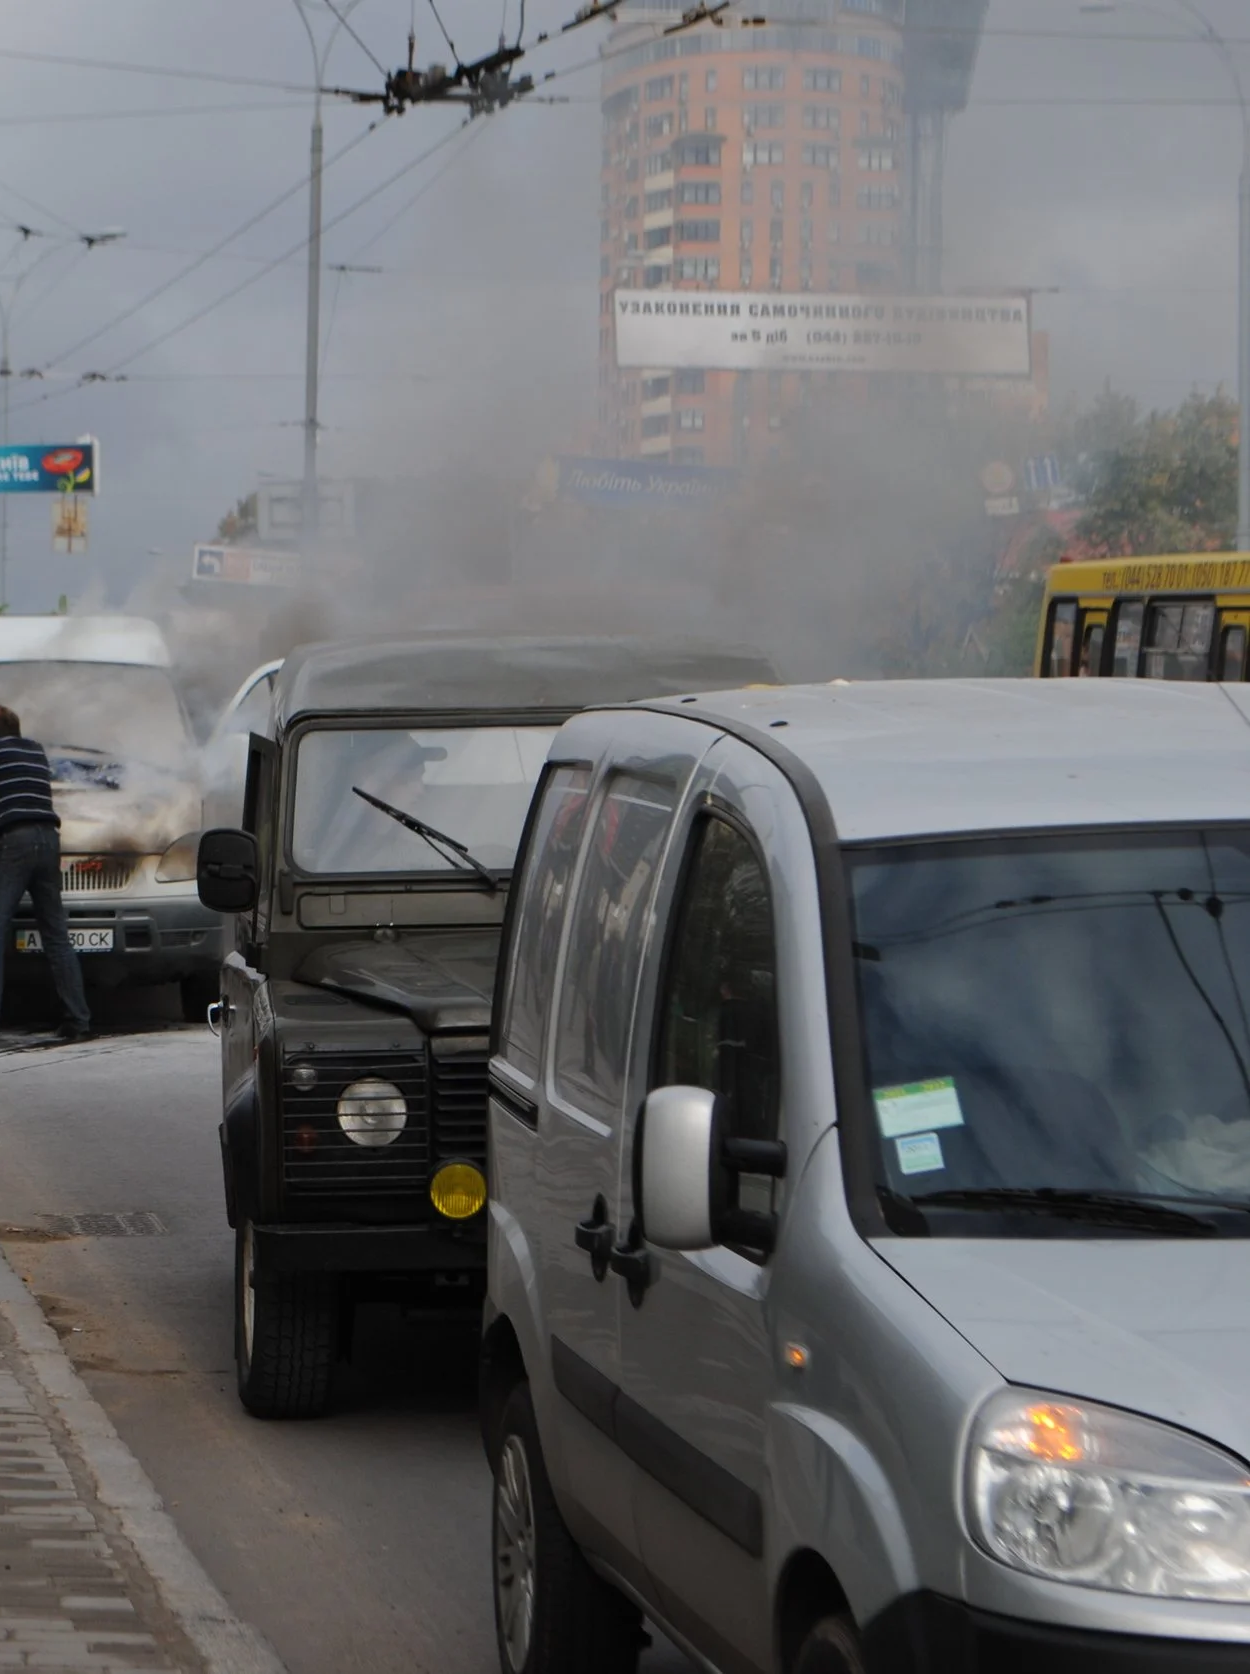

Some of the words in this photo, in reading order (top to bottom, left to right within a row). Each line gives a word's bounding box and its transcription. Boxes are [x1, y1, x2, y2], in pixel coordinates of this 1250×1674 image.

[618, 301, 741, 318] УЗАКОНЕННЯ
[748, 303, 885, 321] САМОЧИННОГО
[766, 329, 788, 345] діб
[568, 469, 643, 494] Любіть
[88, 931, 110, 947] CK
